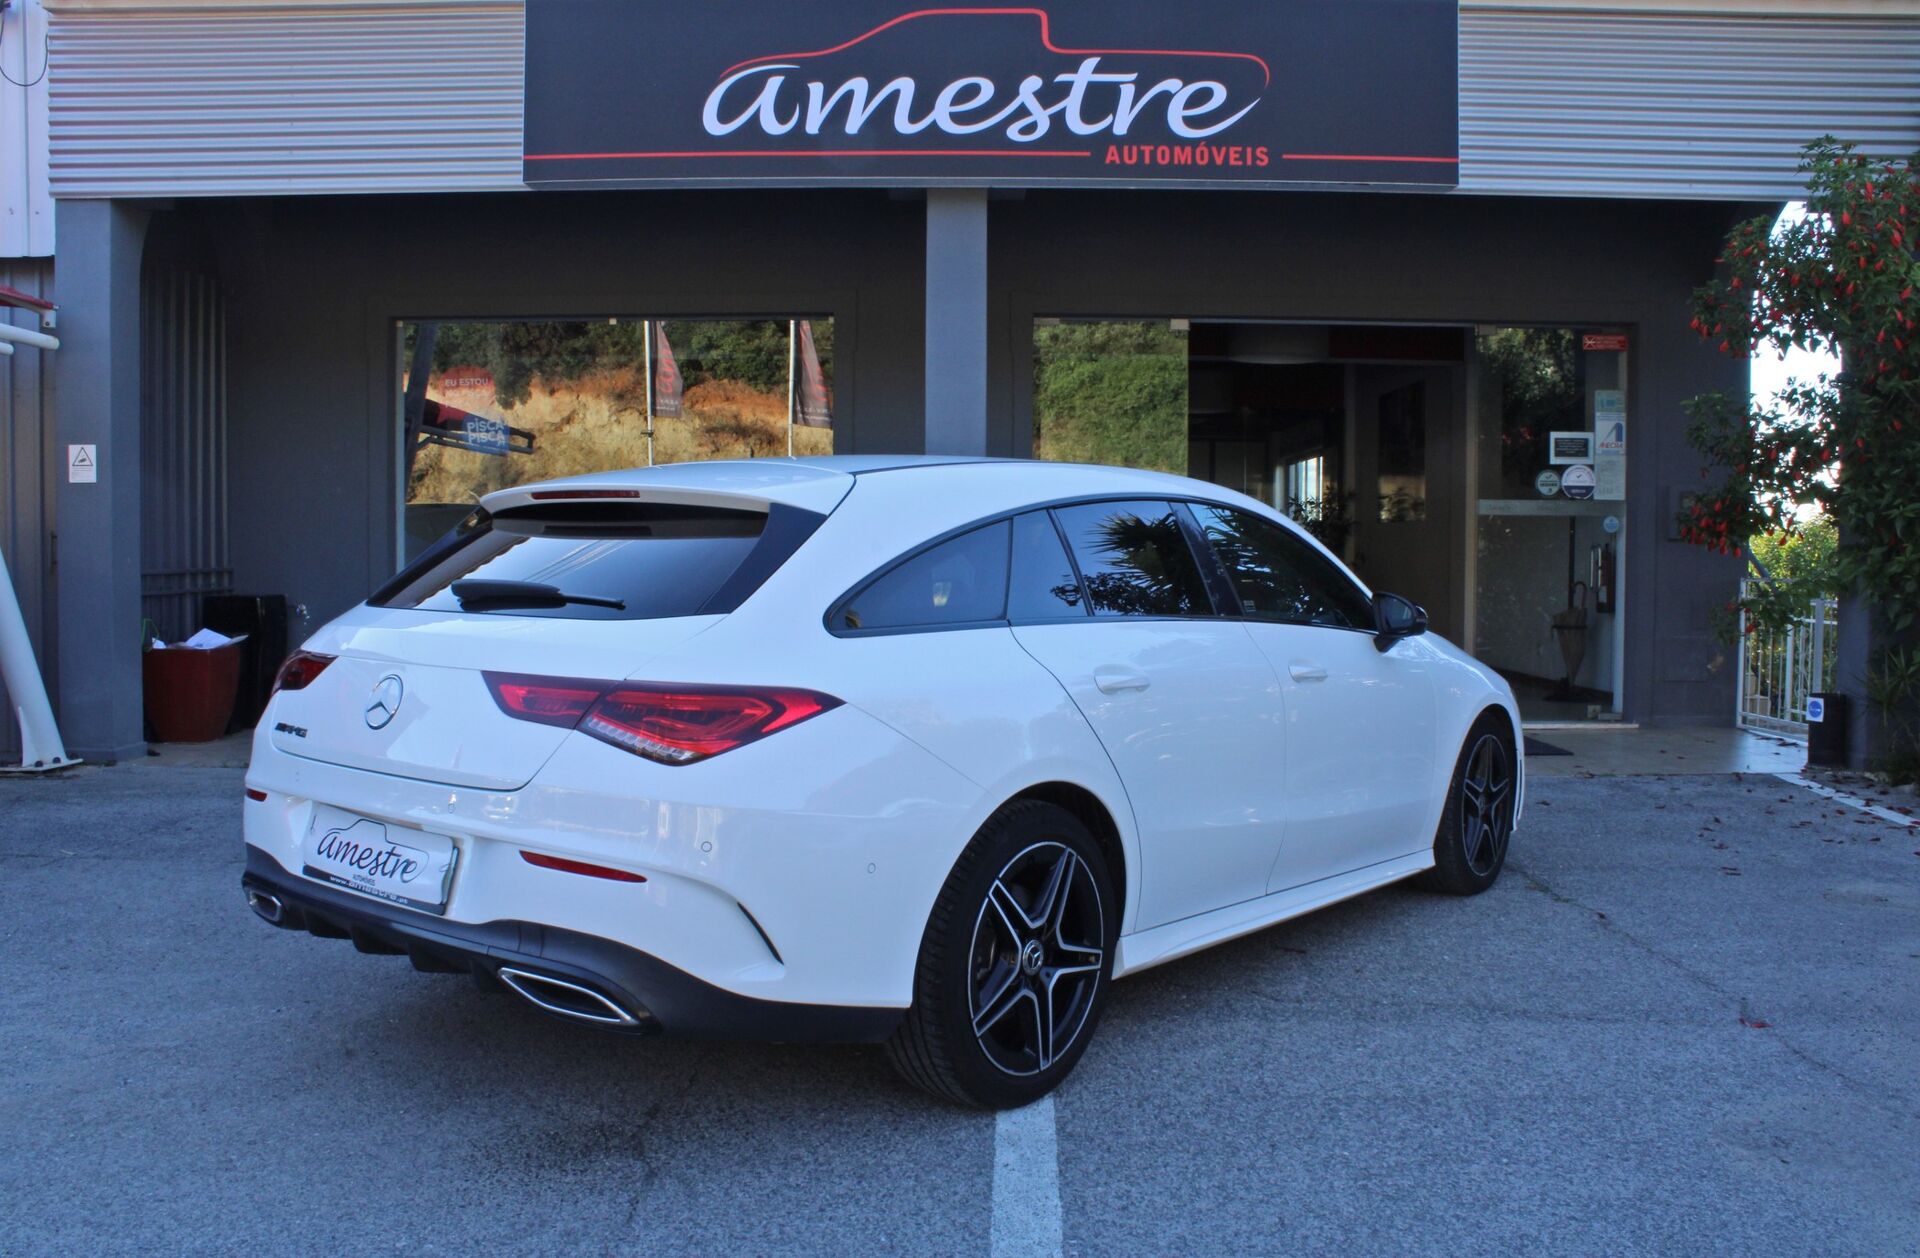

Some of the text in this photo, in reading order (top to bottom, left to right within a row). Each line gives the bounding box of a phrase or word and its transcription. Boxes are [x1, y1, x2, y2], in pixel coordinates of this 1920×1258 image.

[702, 57, 1261, 142] amestre
[1104, 142, 1270, 167] AUTOMÓVEIS
[445, 378, 489, 388] EU ESTOU
[317, 831, 420, 884] amestre
